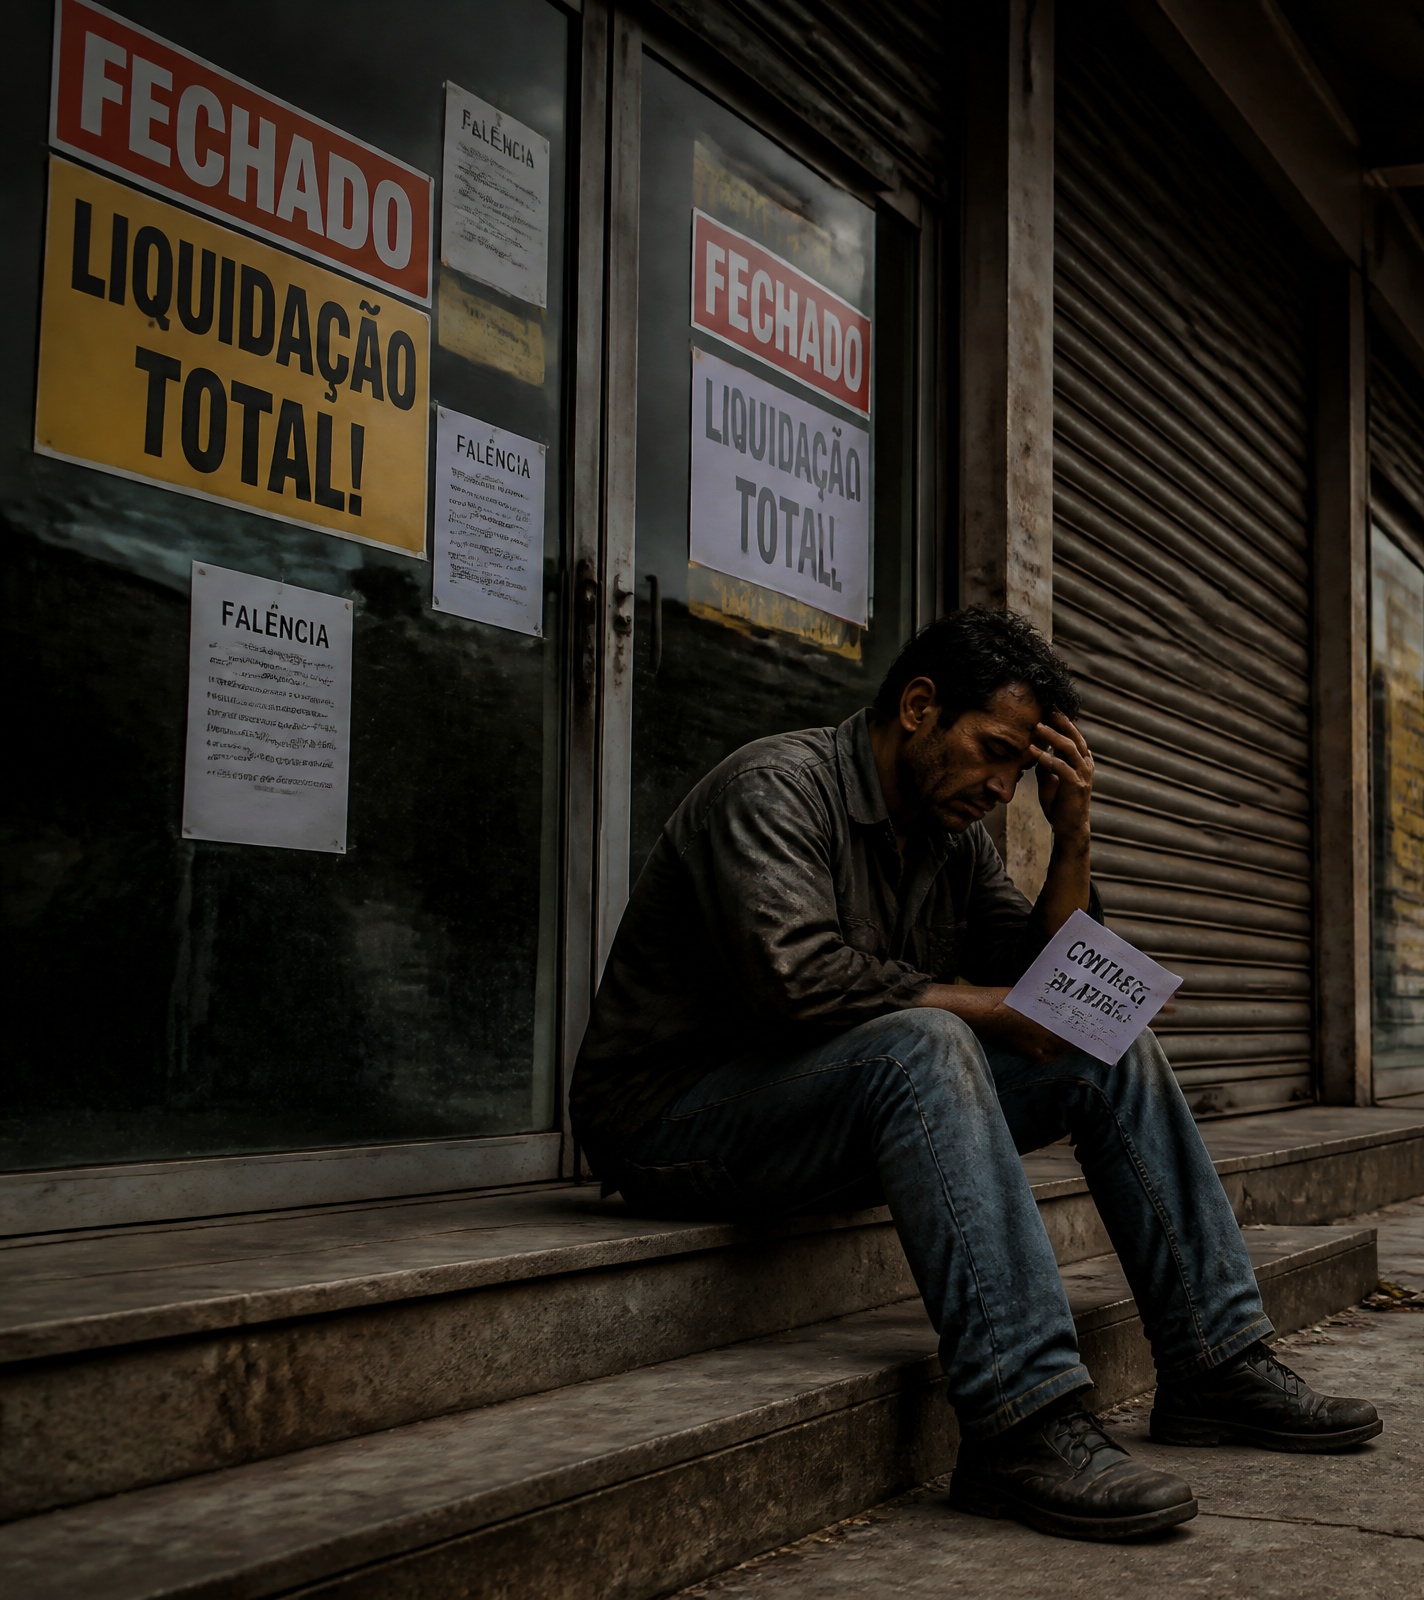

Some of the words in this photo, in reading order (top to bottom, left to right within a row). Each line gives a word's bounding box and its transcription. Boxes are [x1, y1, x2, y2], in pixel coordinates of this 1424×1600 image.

[81, 31, 413, 270] FECHADO
[71, 198, 416, 411] LIQUIDAÇÃO
[705, 240, 863, 393] FECHADO
[135, 345, 365, 517] TOTAL!
[457, 434, 530, 479] FALÊNCIA
[705, 377, 861, 503] LIQUIDAÇÃO
[221, 600, 329, 649] FALÊNCIA
